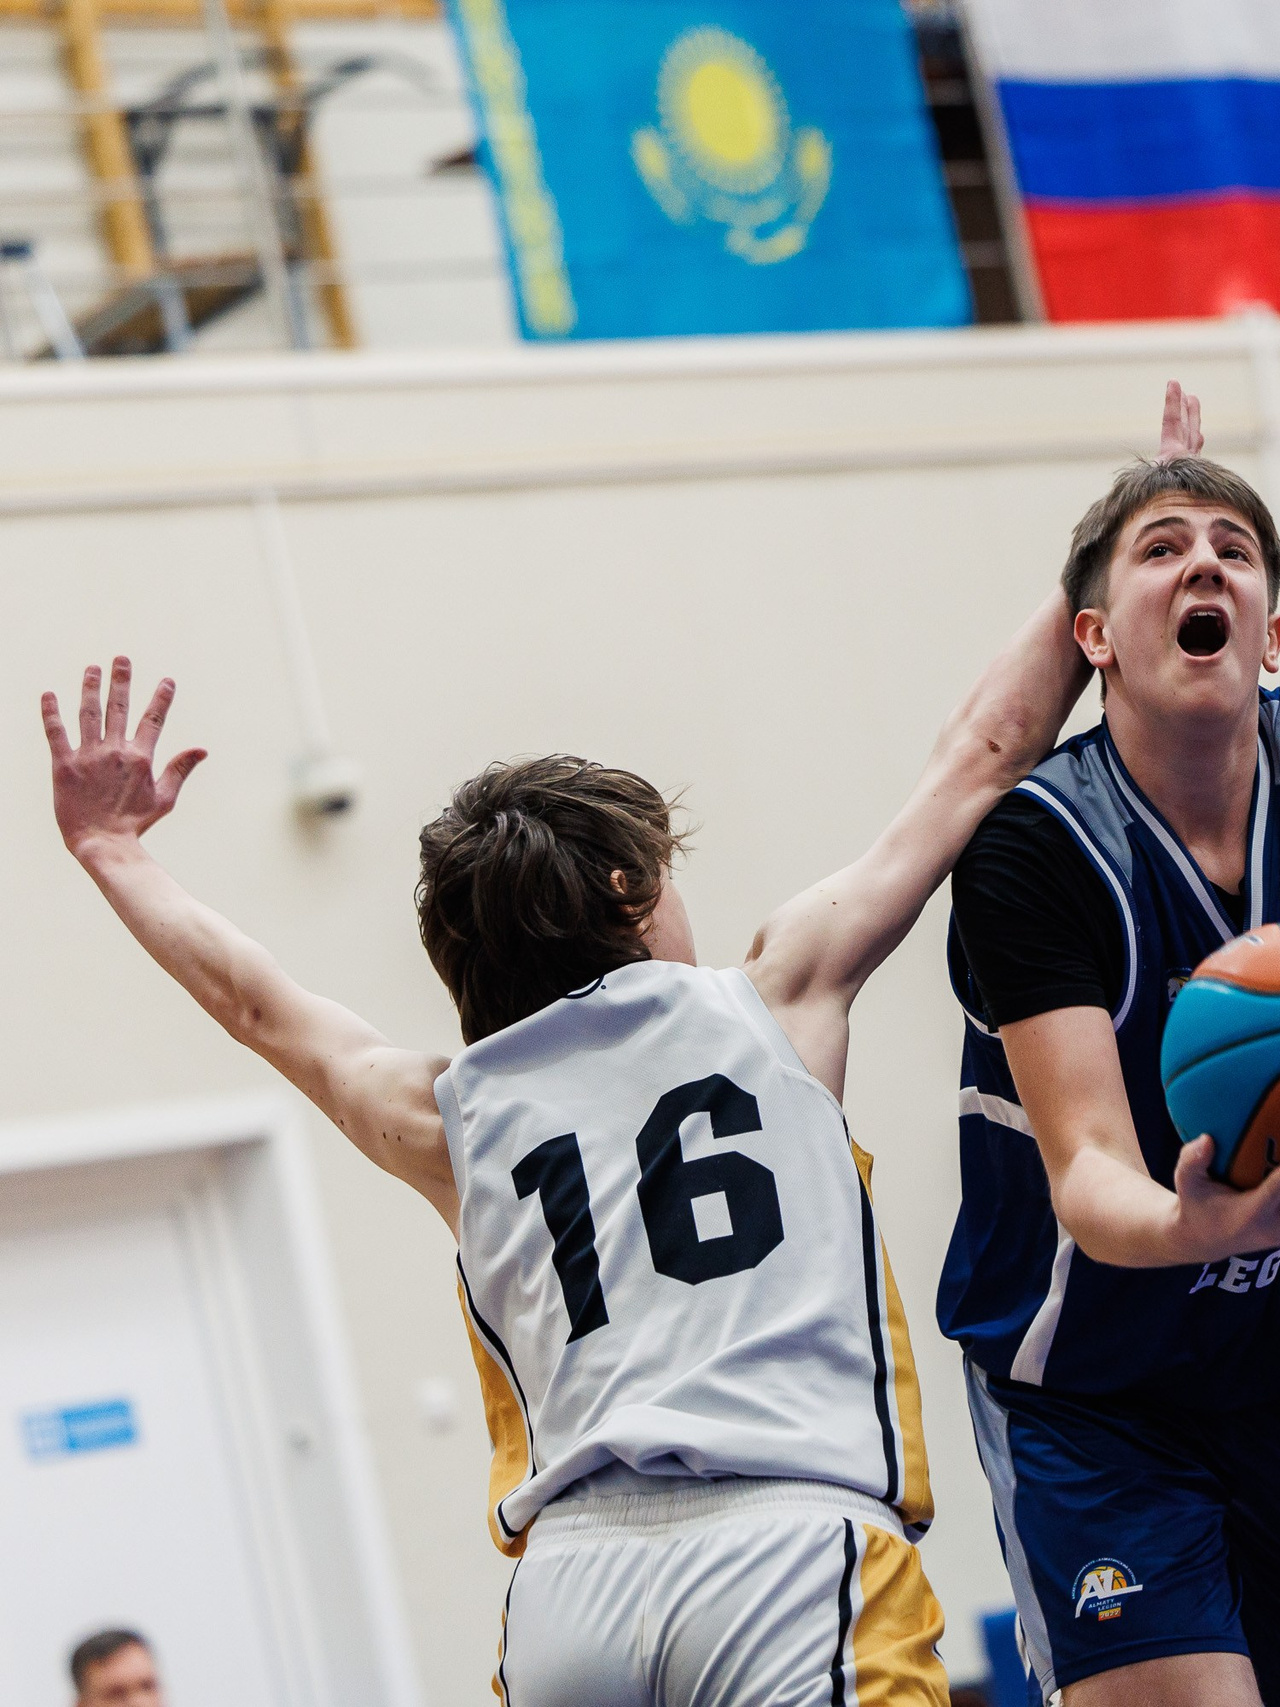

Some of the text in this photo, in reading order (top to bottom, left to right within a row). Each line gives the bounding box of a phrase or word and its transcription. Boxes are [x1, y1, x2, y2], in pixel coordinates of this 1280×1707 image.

[511, 1073, 785, 1346] 16
[1088, 1598, 1115, 1609] ALMATY
[1098, 1601, 1122, 1612] LEGION
